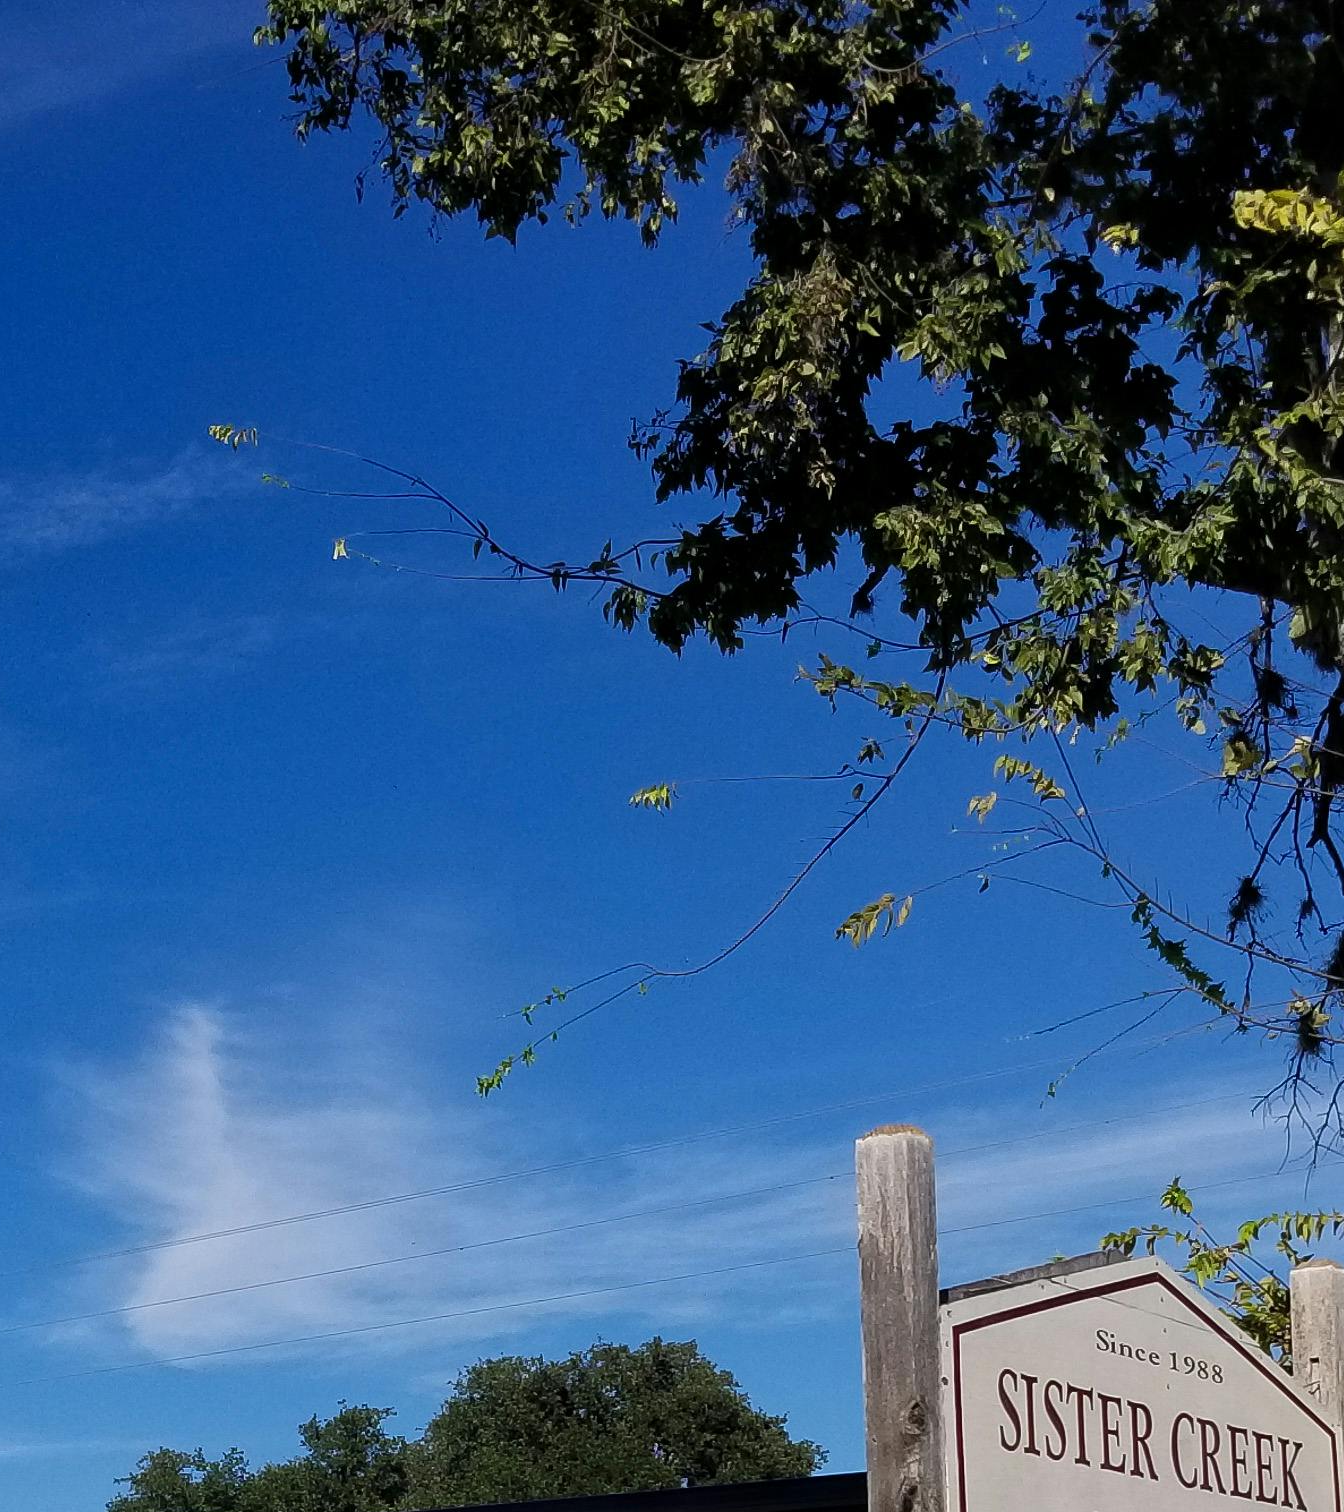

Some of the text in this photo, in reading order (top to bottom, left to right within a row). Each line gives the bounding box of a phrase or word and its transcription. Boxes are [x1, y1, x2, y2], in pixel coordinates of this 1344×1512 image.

[1095, 1329, 1225, 1384] Since 1988
[997, 1368, 1308, 1512] SISTER CREEK
